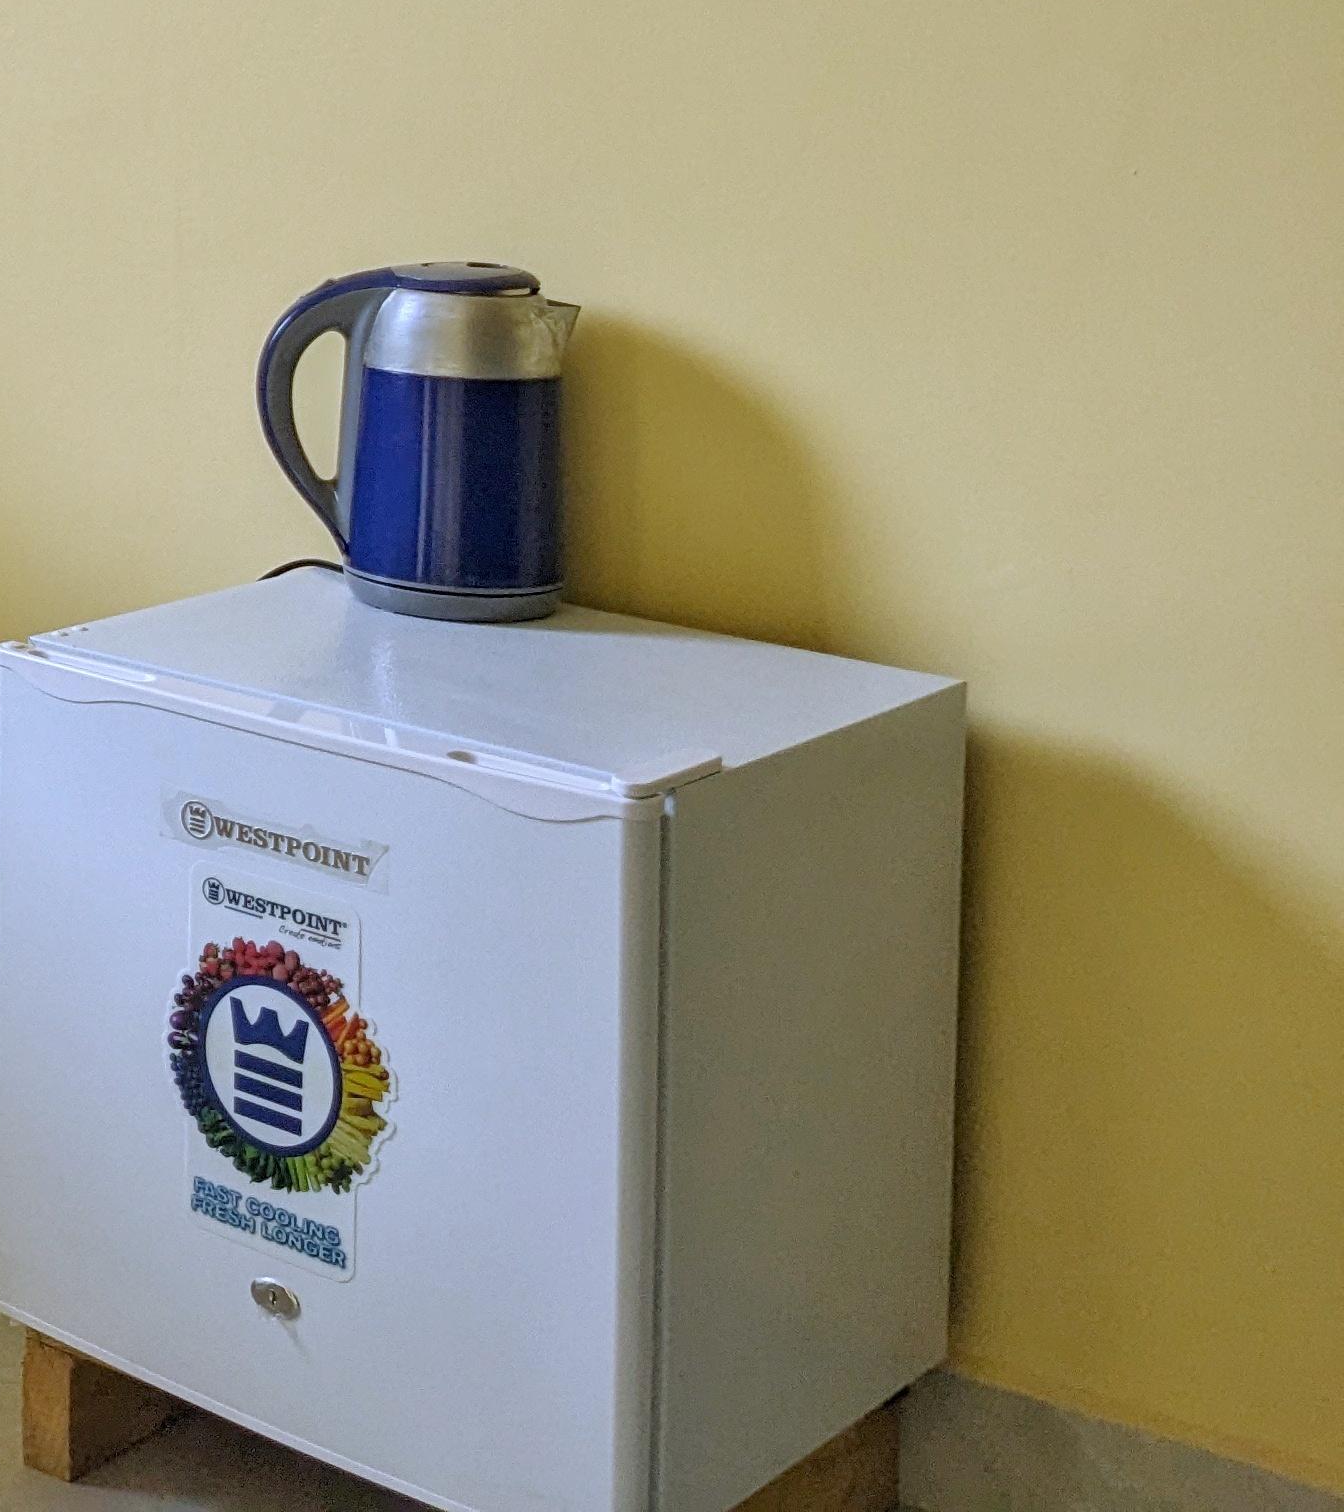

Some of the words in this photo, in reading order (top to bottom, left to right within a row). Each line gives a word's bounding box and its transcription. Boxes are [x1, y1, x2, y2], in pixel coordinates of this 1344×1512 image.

[213, 815, 370, 877] WESTPOINT
[225, 888, 343, 936] WESTPOINT
[191, 1193, 256, 1234] FRESH
[261, 1221, 346, 1269] LONGER
[193, 1176, 242, 1208] FAST
[245, 1196, 341, 1246] COOLING
